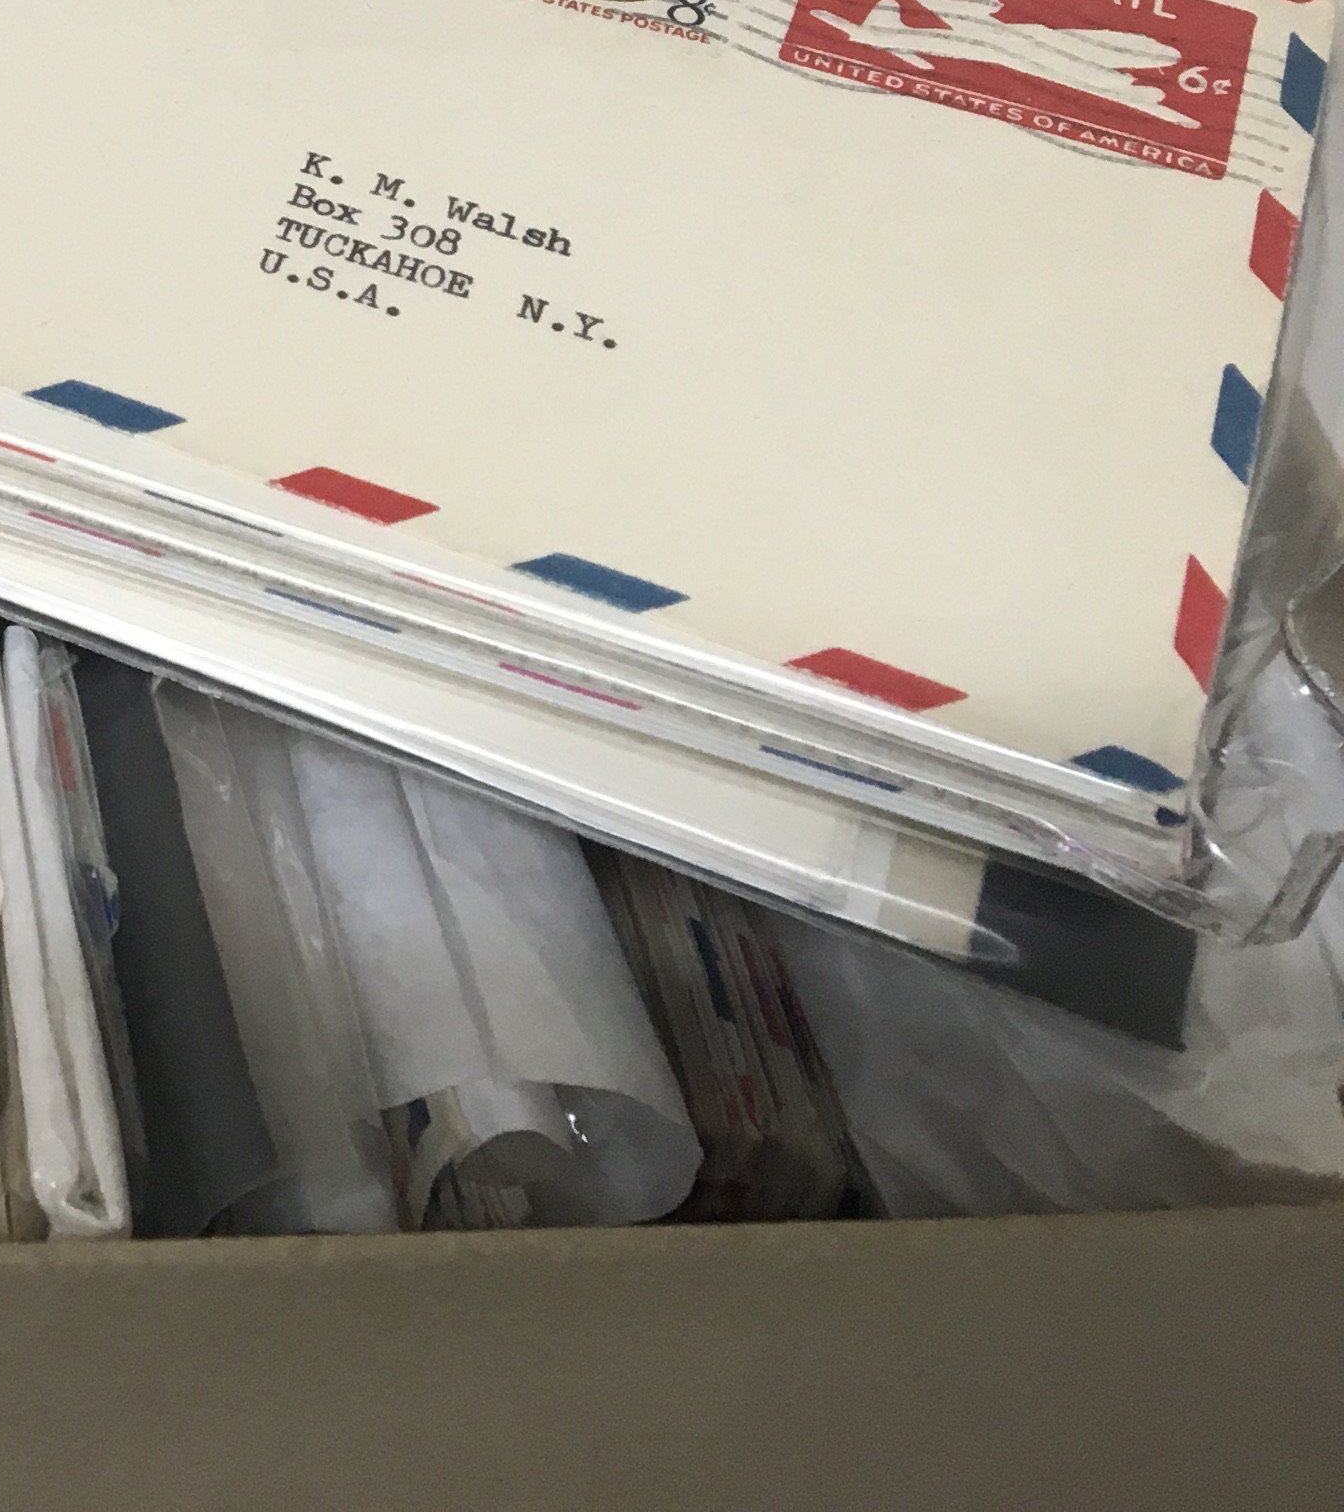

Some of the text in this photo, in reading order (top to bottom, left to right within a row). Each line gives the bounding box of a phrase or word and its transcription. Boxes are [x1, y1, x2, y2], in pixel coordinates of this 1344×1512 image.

[619, 10, 712, 46] POSTAGE
[792, 50, 1215, 177] UNITED STATES OF AMERICA
[287, 183, 462, 256] Box 308
[300, 151, 572, 257] K. M. Walsh
[259, 248, 401, 317] U.S.A.
[275, 217, 618, 350] TUCKAHOE N.Y.
